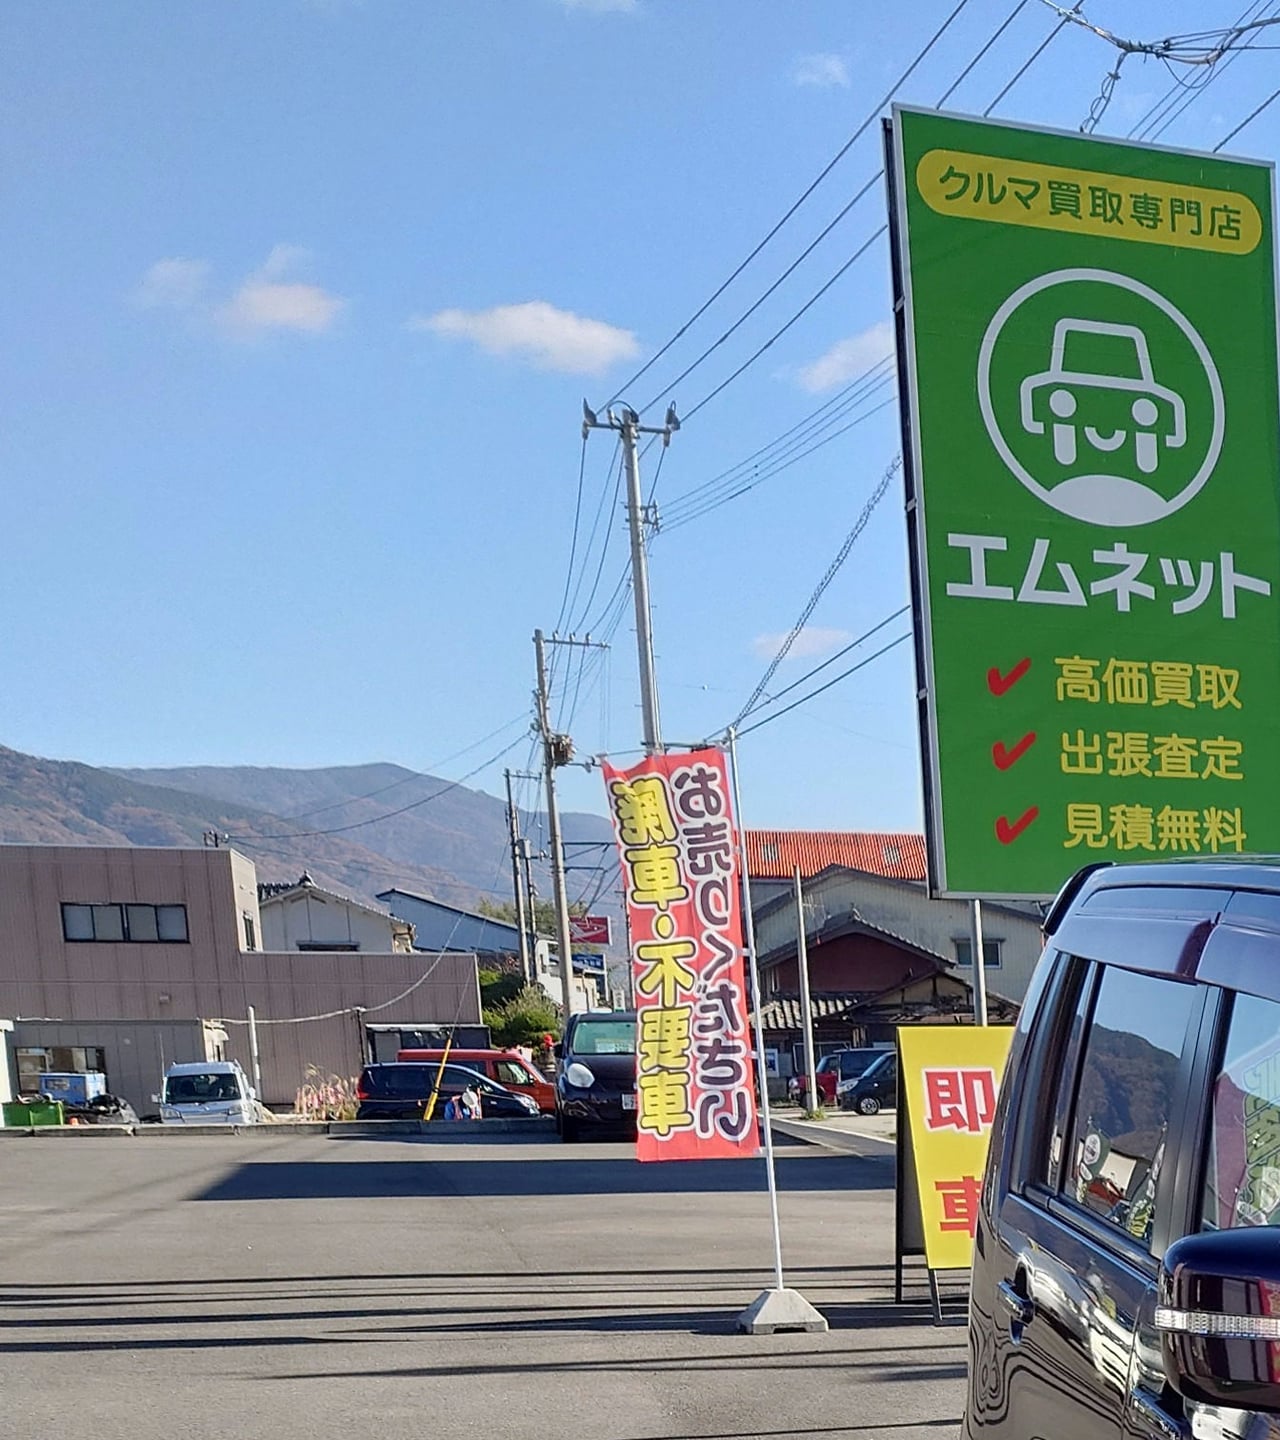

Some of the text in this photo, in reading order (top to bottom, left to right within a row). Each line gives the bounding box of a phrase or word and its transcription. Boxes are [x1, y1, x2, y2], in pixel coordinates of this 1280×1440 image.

[939, 165, 1242, 241] クルマ買取専門店
[946, 532, 1271, 619] エムネット
[1055, 655, 1243, 710] 高価買取
[1060, 729, 1244, 780] 出張査定
[1063, 803, 1247, 853] 見積無料
